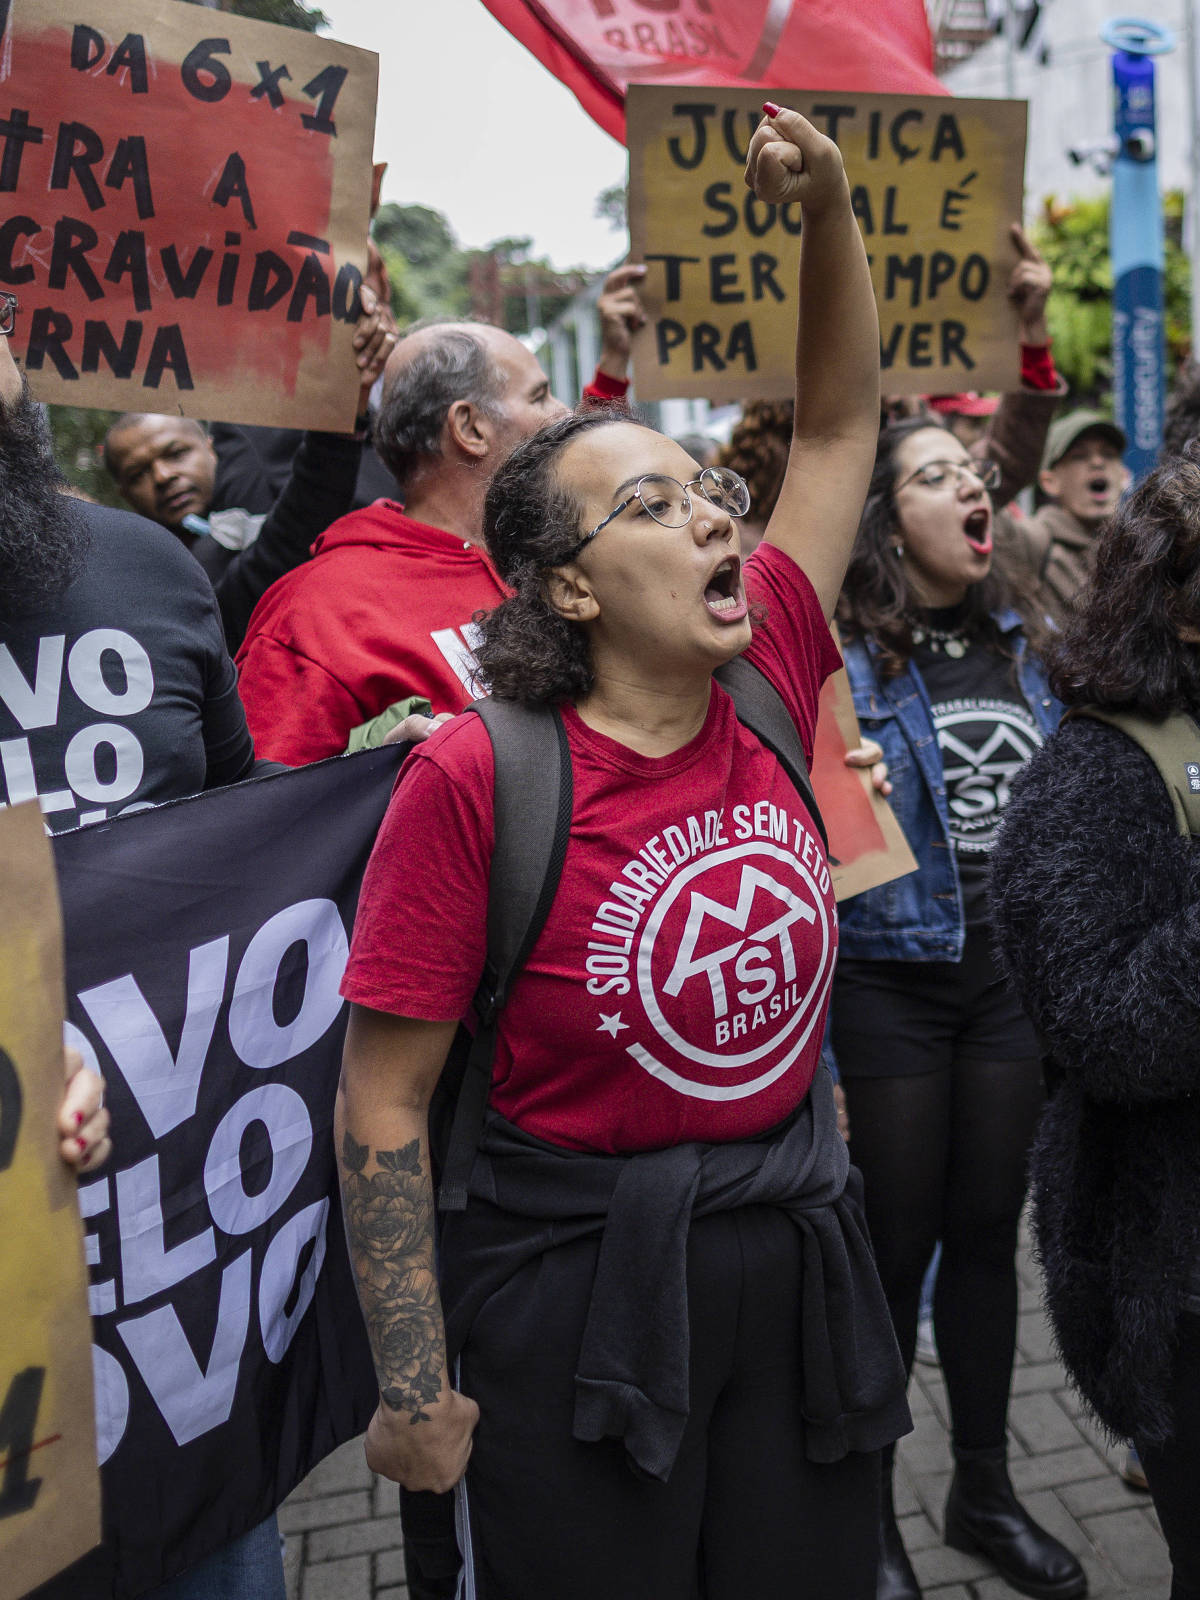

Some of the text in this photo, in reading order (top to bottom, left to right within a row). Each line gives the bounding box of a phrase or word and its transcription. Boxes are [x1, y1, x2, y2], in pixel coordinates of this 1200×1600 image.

[71, 24, 148, 93] DA
[668, 103, 965, 169] JUTIÇA
[212, 151, 257, 230] A
[940, 171, 978, 231] É
[644, 252, 785, 303] TER
[656, 319, 757, 372] PRA
[586, 800, 831, 996] SOLIDARIEDADE SEM TETO
[715, 983, 803, 1046] BRASIL
